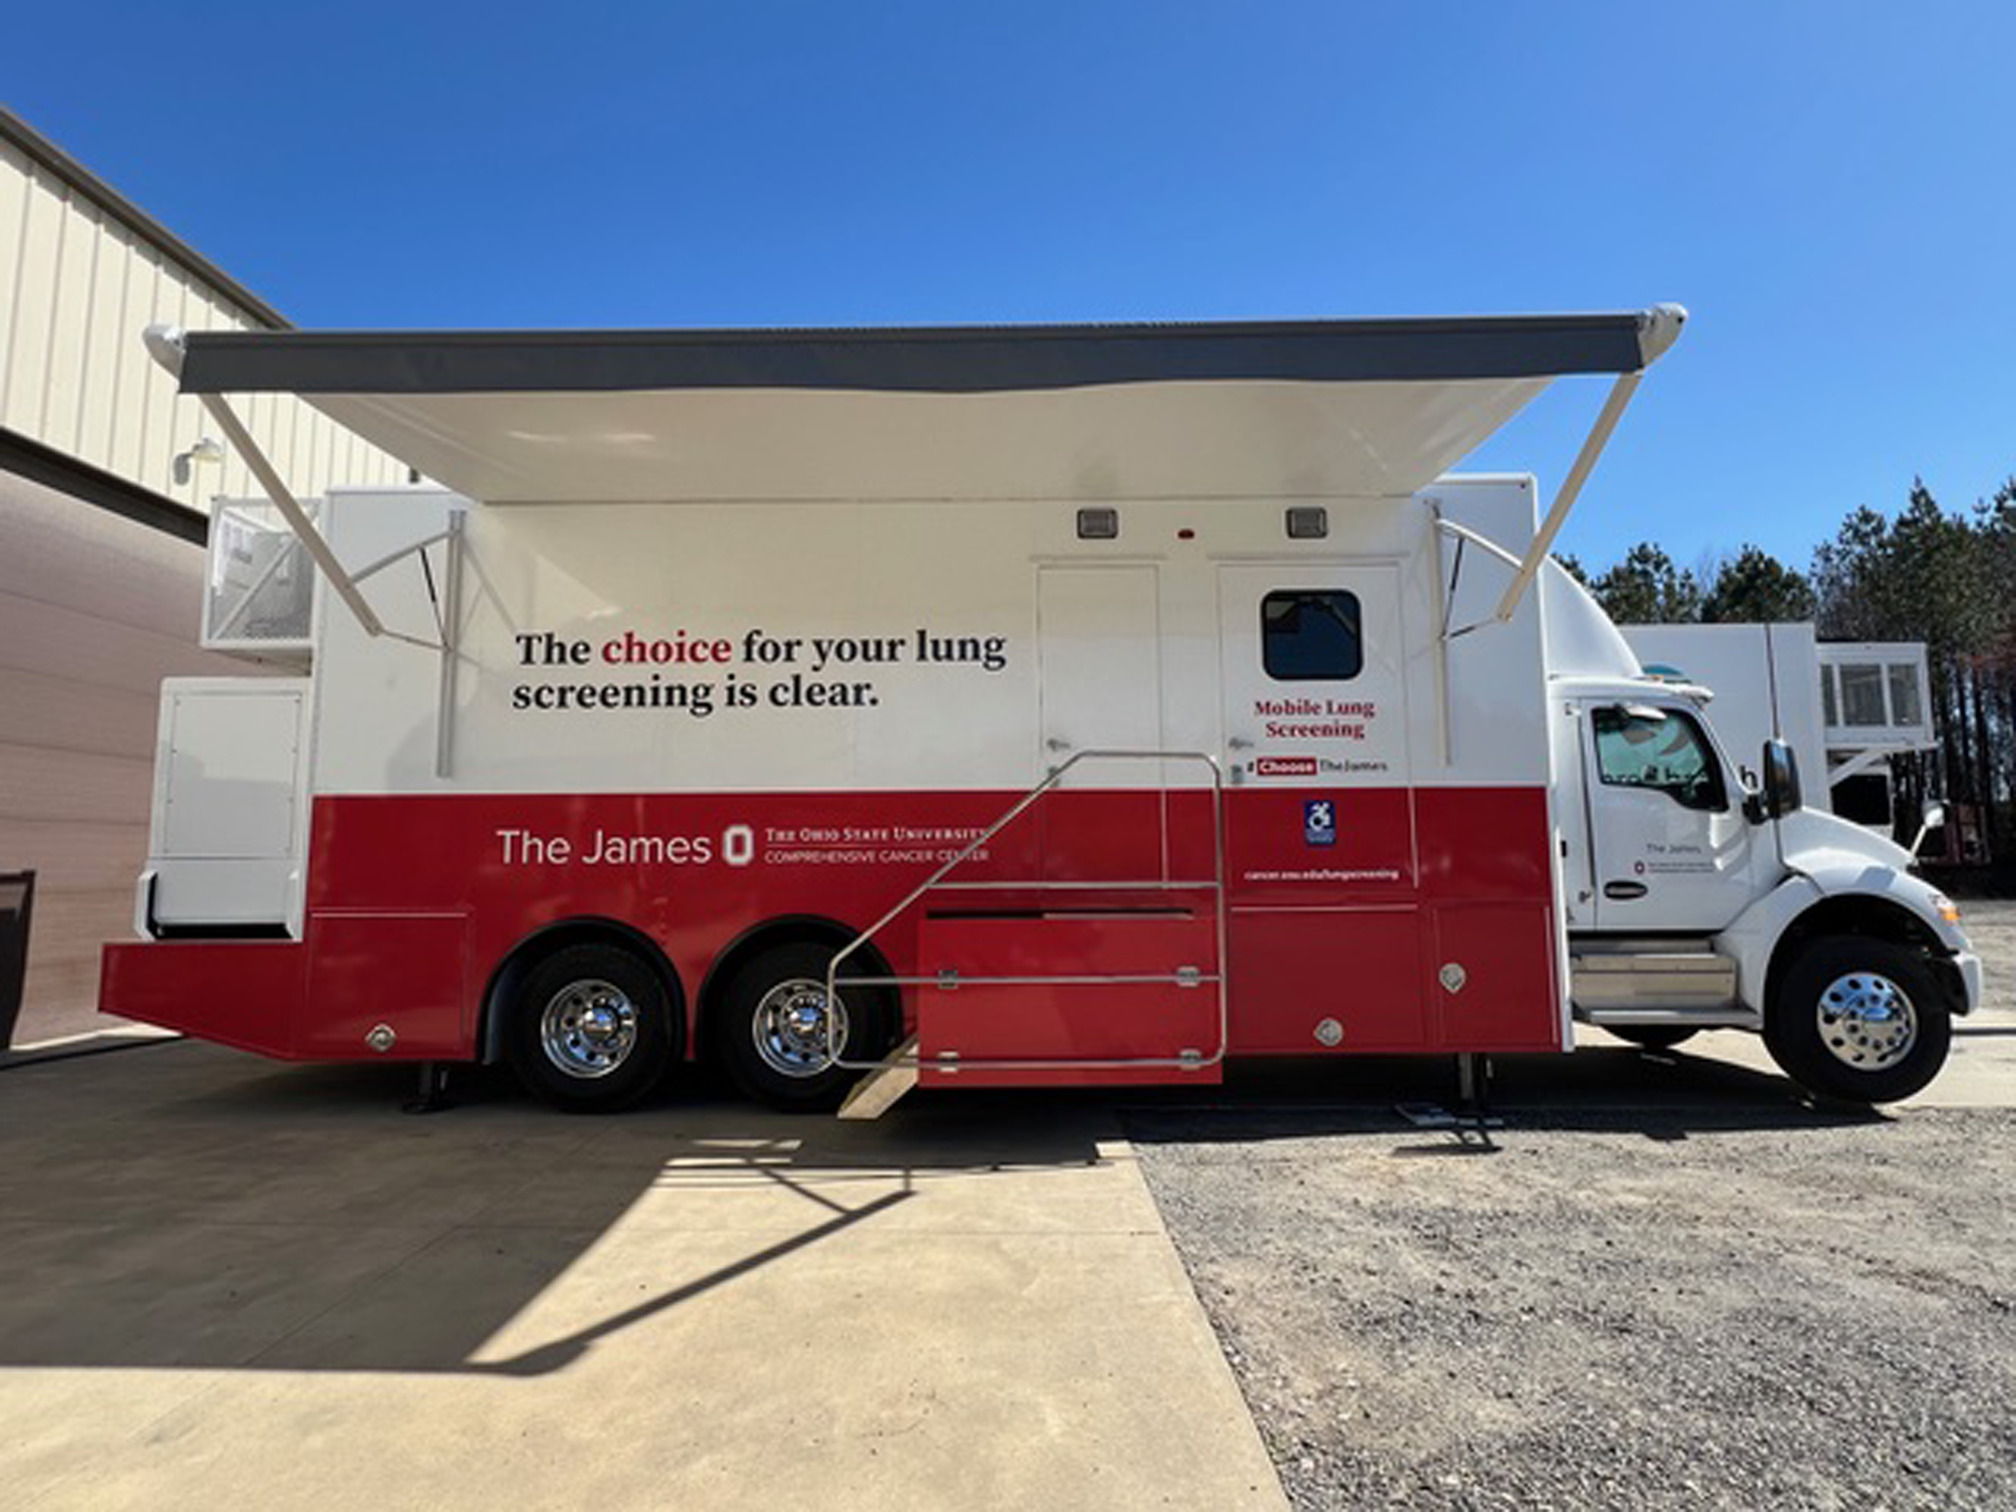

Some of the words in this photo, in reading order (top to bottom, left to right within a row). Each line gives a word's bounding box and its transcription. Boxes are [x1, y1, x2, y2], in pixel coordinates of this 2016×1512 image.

[516, 633, 591, 664] The
[602, 630, 732, 664] choice
[743, 630, 802, 663] for
[812, 638, 906, 672] your
[916, 630, 1006, 671] lung
[513, 674, 714, 717] screening
[726, 674, 758, 706] is
[768, 673, 880, 706] clear.
[1254, 699, 1321, 715] Mobile
[1326, 700, 1375, 718] Lung
[1265, 719, 1366, 740] Screening
[765, 828, 795, 841] THE
[800, 828, 839, 841] OHIO
[843, 827, 889, 841] STATE
[496, 830, 571, 864] The
[582, 830, 712, 864] James
[765, 850, 875, 863] COMPREHENSIVE
[879, 850, 933, 862] CANCER
[936, 849, 989, 862] CENER
